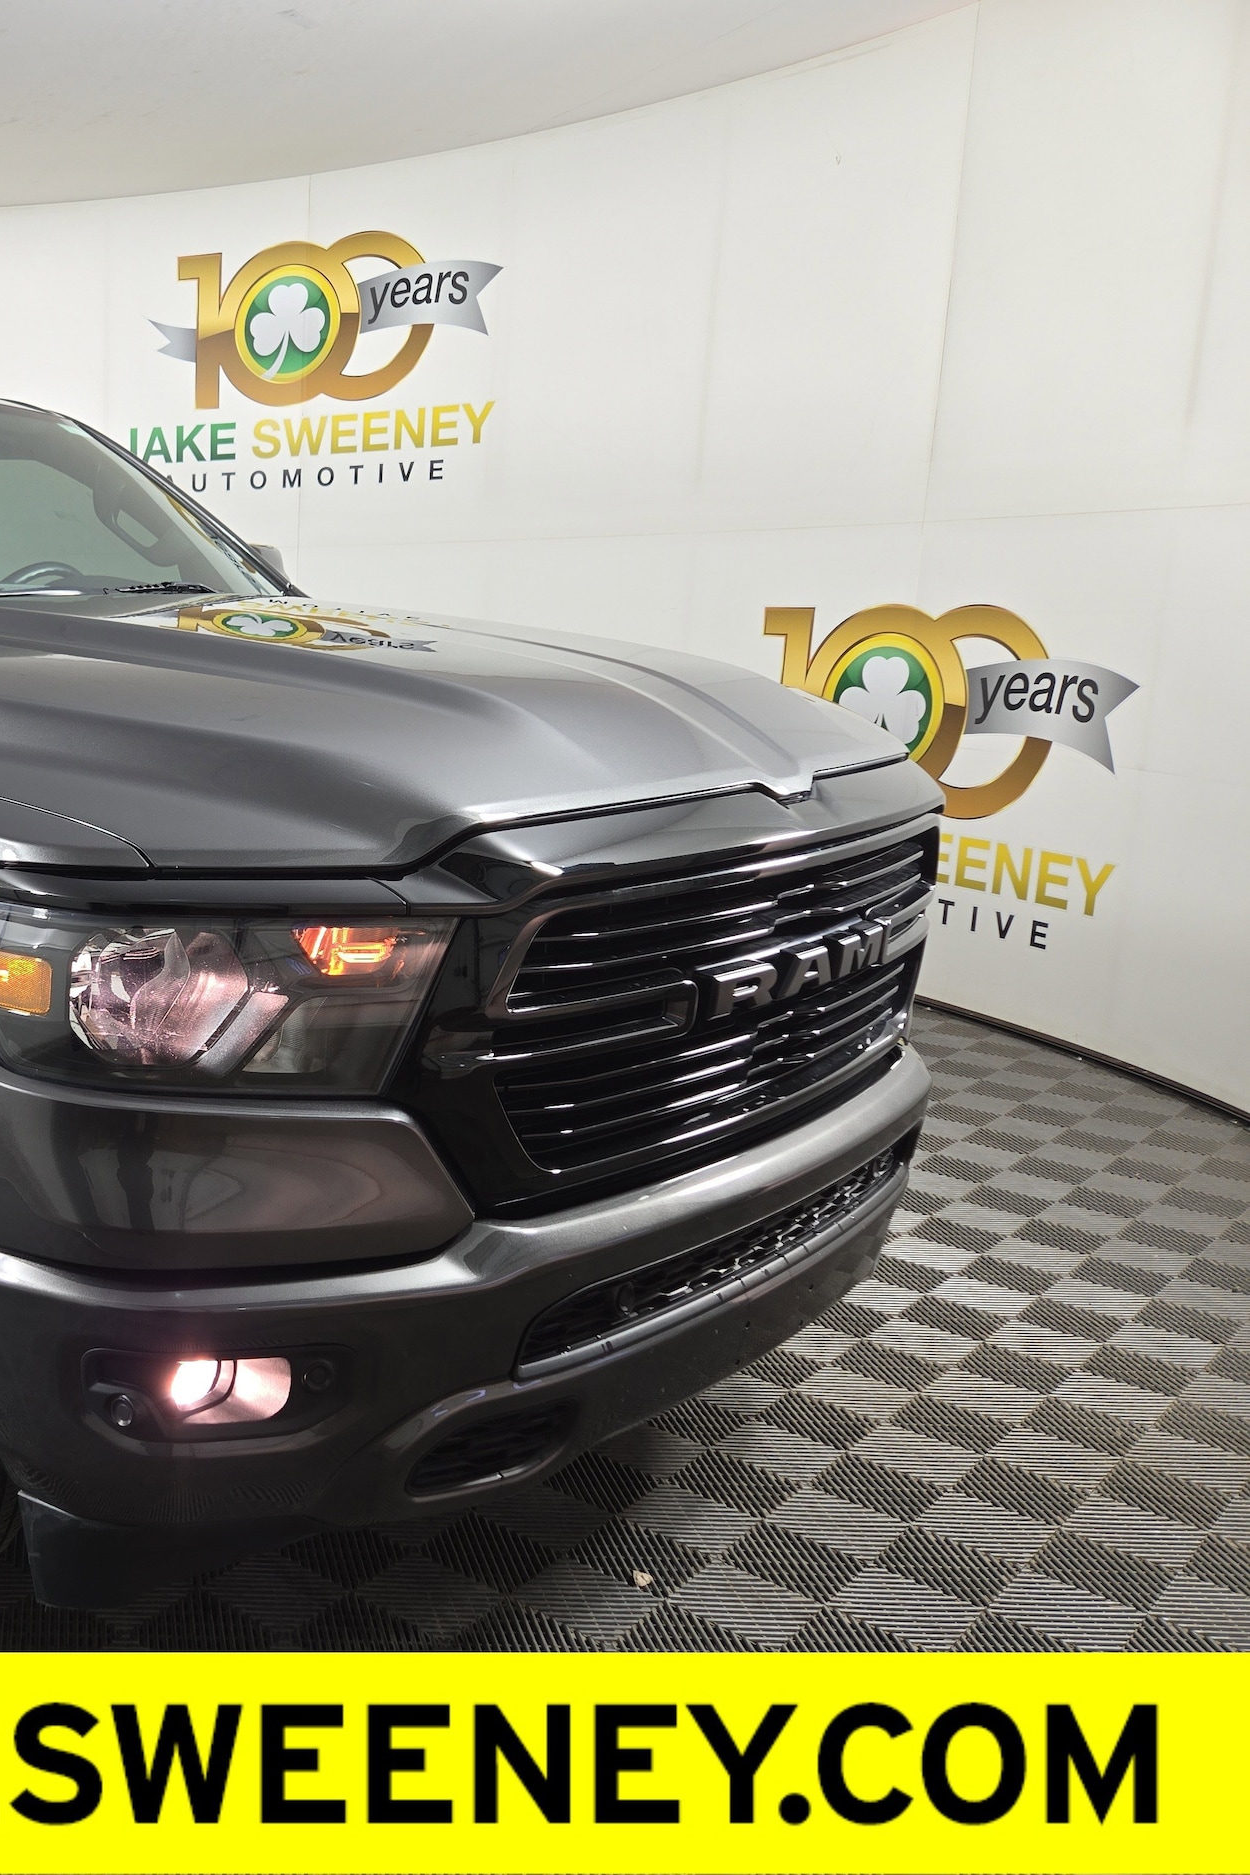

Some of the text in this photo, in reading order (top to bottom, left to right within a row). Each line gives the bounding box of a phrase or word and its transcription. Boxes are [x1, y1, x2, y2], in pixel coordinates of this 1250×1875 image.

[367, 268, 469, 324] years
[250, 401, 496, 460] SWEENEY
[166, 459, 445, 493] UTOMOTIVE
[973, 671, 1099, 725] years
[937, 832, 1117, 917] ENEY
[702, 921, 884, 1021] RAM
